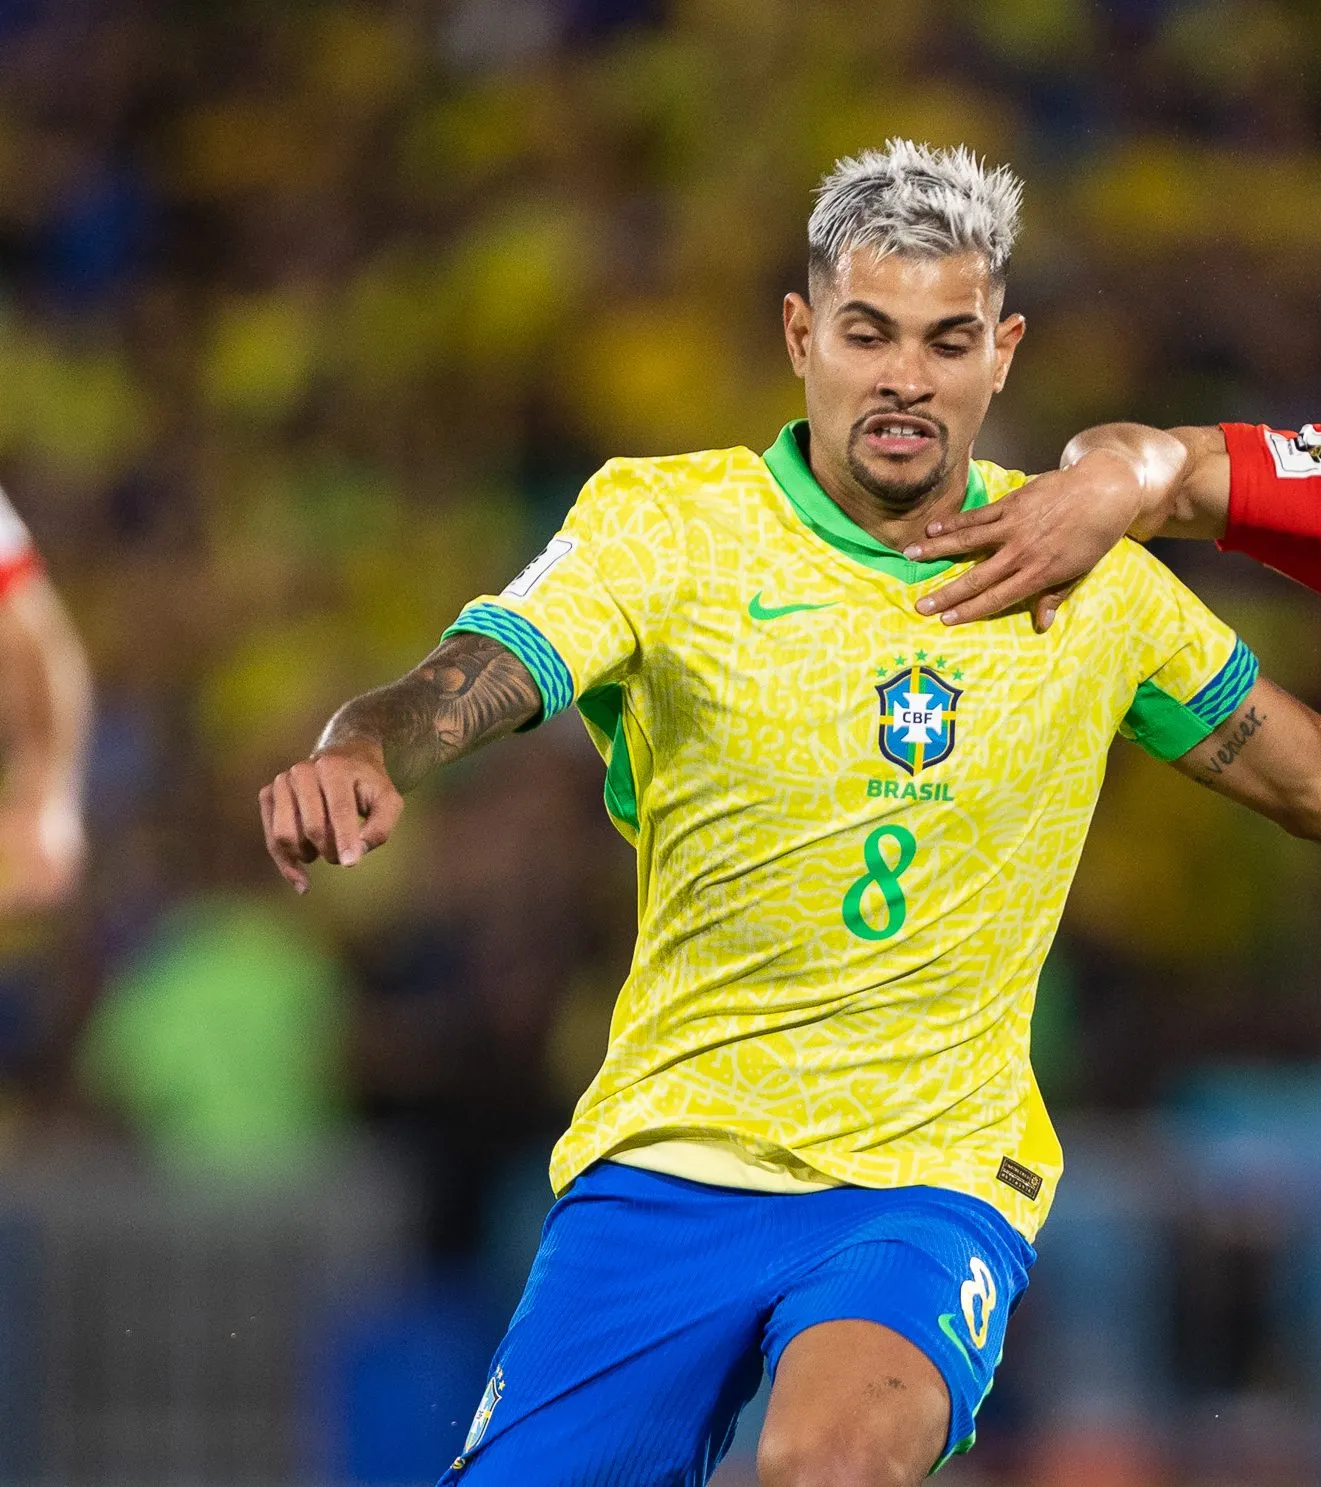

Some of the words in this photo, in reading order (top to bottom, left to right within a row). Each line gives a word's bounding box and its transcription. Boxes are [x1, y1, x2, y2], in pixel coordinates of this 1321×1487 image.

[902, 710, 933, 725] CBF
[866, 778, 955, 802] BRASIL
[842, 824, 917, 941] 8
[960, 1256, 997, 1350] 8
